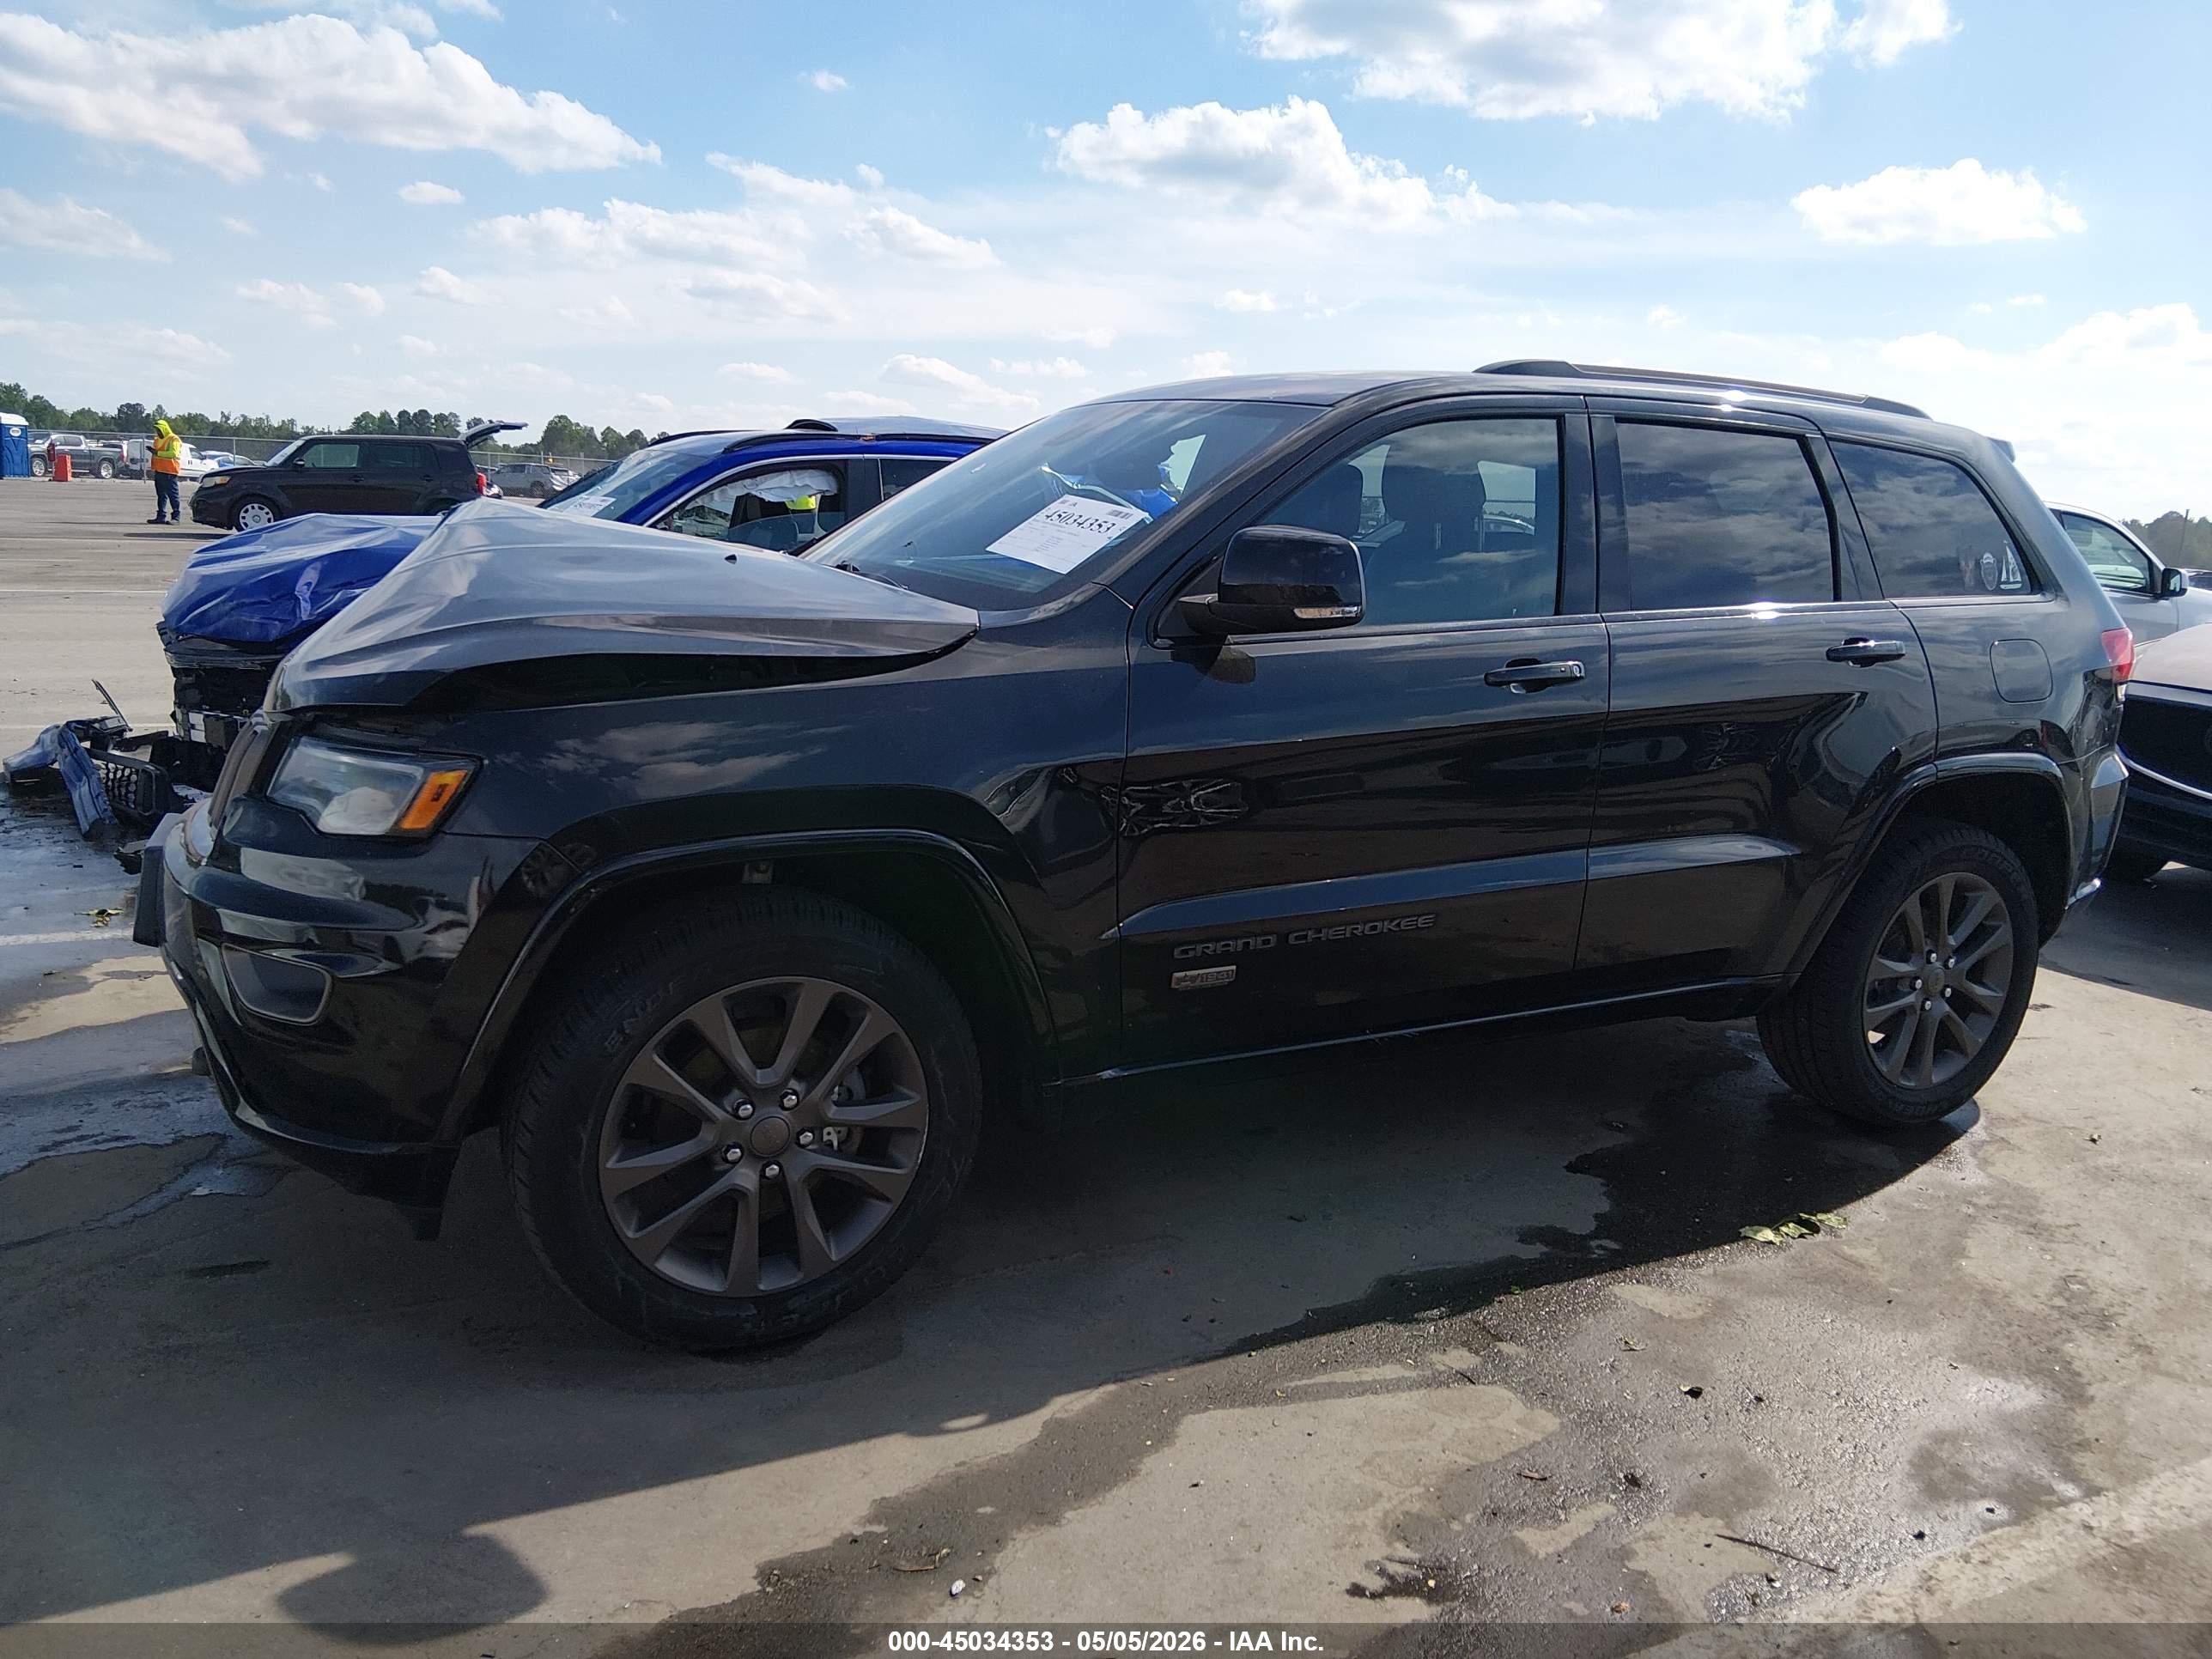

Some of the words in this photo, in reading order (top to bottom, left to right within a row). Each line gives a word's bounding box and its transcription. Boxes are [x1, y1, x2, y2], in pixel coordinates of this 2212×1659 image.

[1044, 509, 1116, 534] 45034353
[1173, 933, 1277, 959] GRAND
[1288, 914, 1436, 945] CHEROKEE
